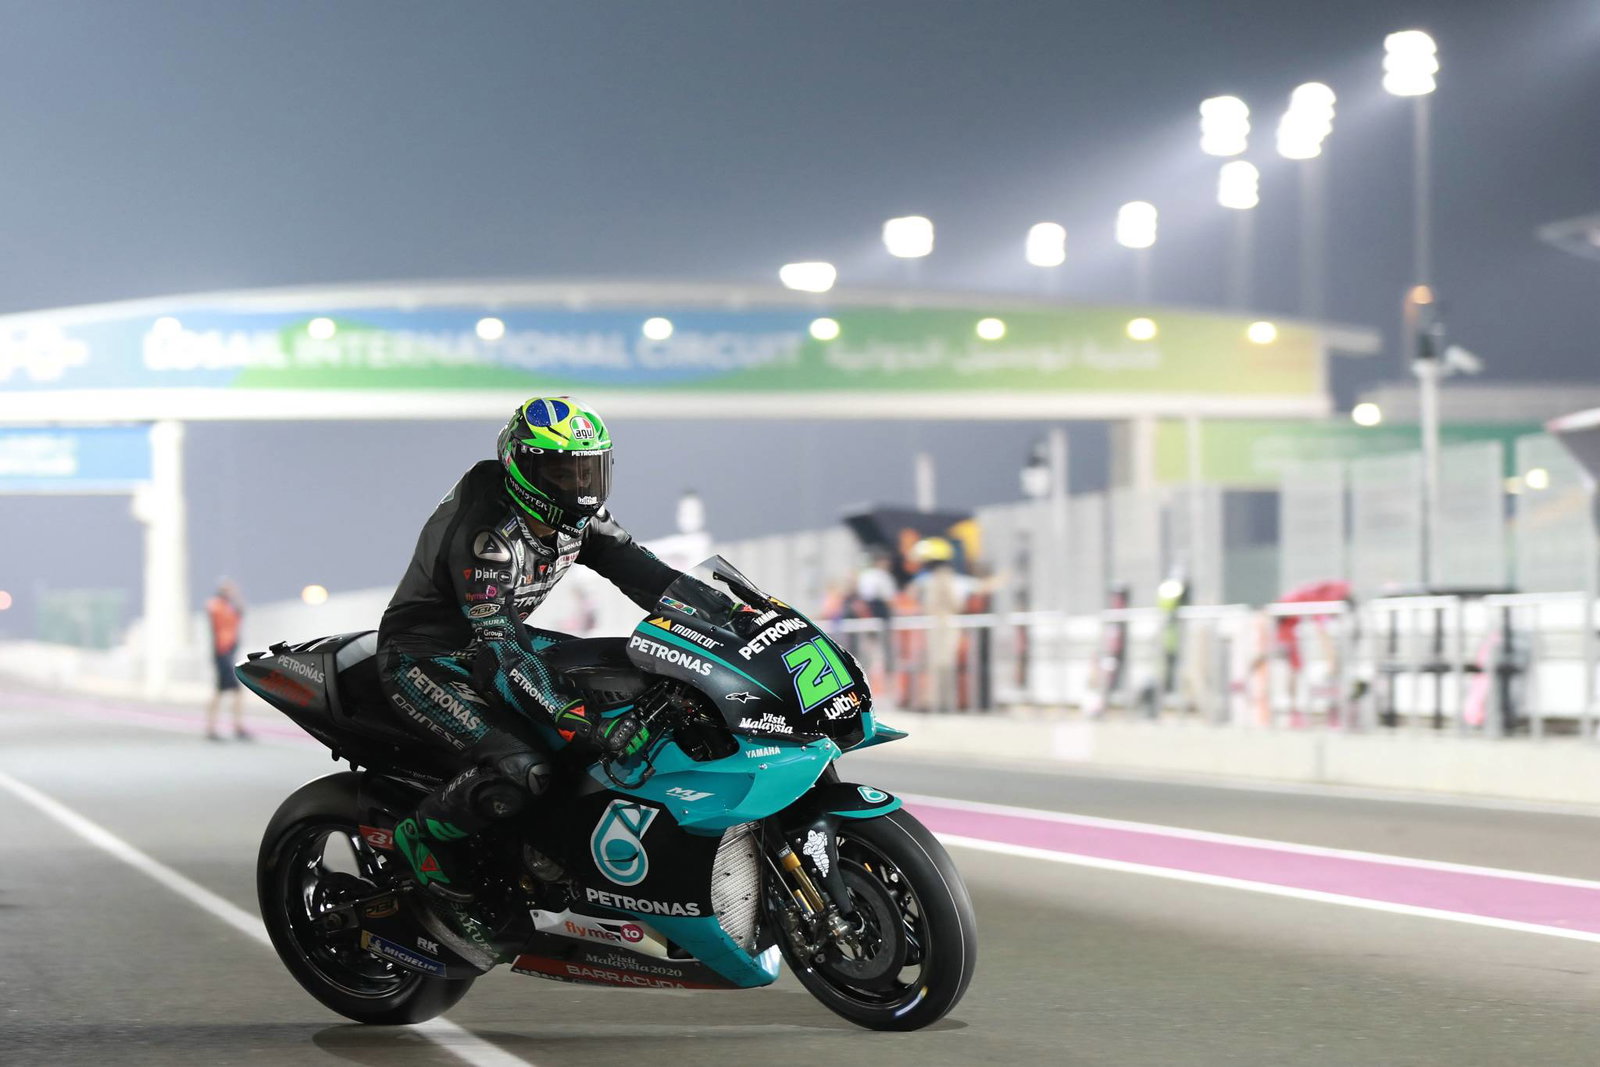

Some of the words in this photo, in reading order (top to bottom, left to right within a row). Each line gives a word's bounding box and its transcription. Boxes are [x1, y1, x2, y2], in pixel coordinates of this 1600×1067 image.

[738, 617, 808, 660] PETRONAS
[277, 654, 325, 684] PETRONAS
[629, 635, 713, 676] PETRONAS
[781, 634, 855, 714] 21
[405, 666, 481, 731] PETRONAS
[509, 667, 556, 715] PETRONAS
[391, 693, 466, 751] DAINESE
[739, 717, 794, 735] Malaysia
[762, 712, 787, 726] Visit
[745, 744, 781, 759] YAMAHA
[586, 887, 700, 917] PETRONAS
[384, 946, 439, 972] MICHELIN
[417, 936, 439, 954] RK
[608, 953, 637, 965] Visit
[566, 964, 687, 989] BARRACUDA
[585, 954, 649, 972] Malaysia
[650, 965, 683, 977] 2020
